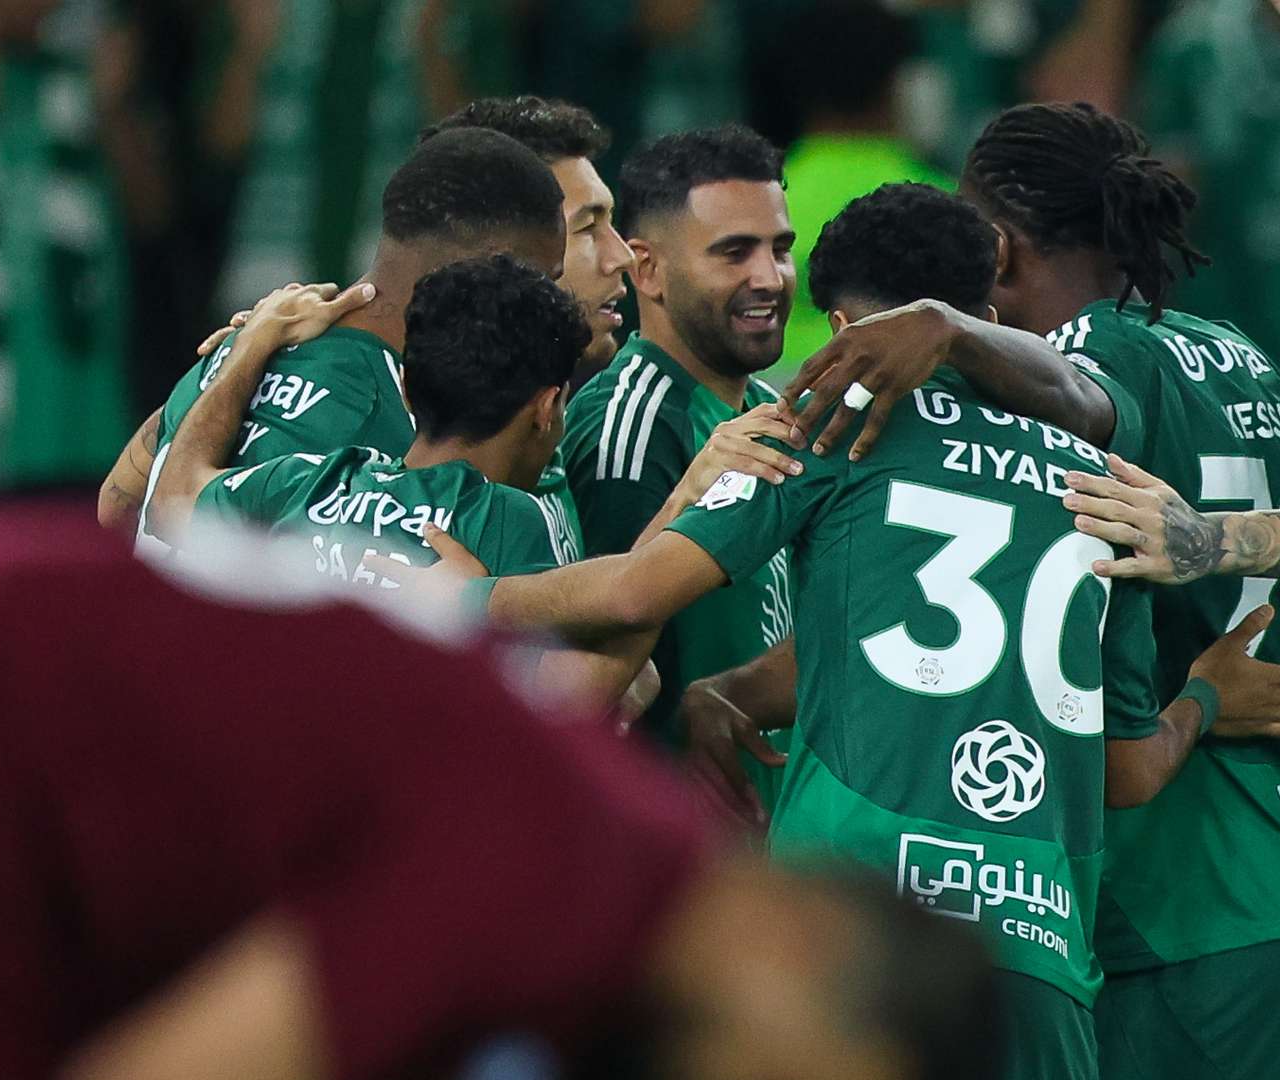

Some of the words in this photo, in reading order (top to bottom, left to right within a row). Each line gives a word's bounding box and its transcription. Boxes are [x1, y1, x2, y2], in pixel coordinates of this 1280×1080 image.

[942, 439, 1076, 497] ZIYAD
[859, 479, 1115, 736] 30
[910, 859, 1071, 920] سينومي
